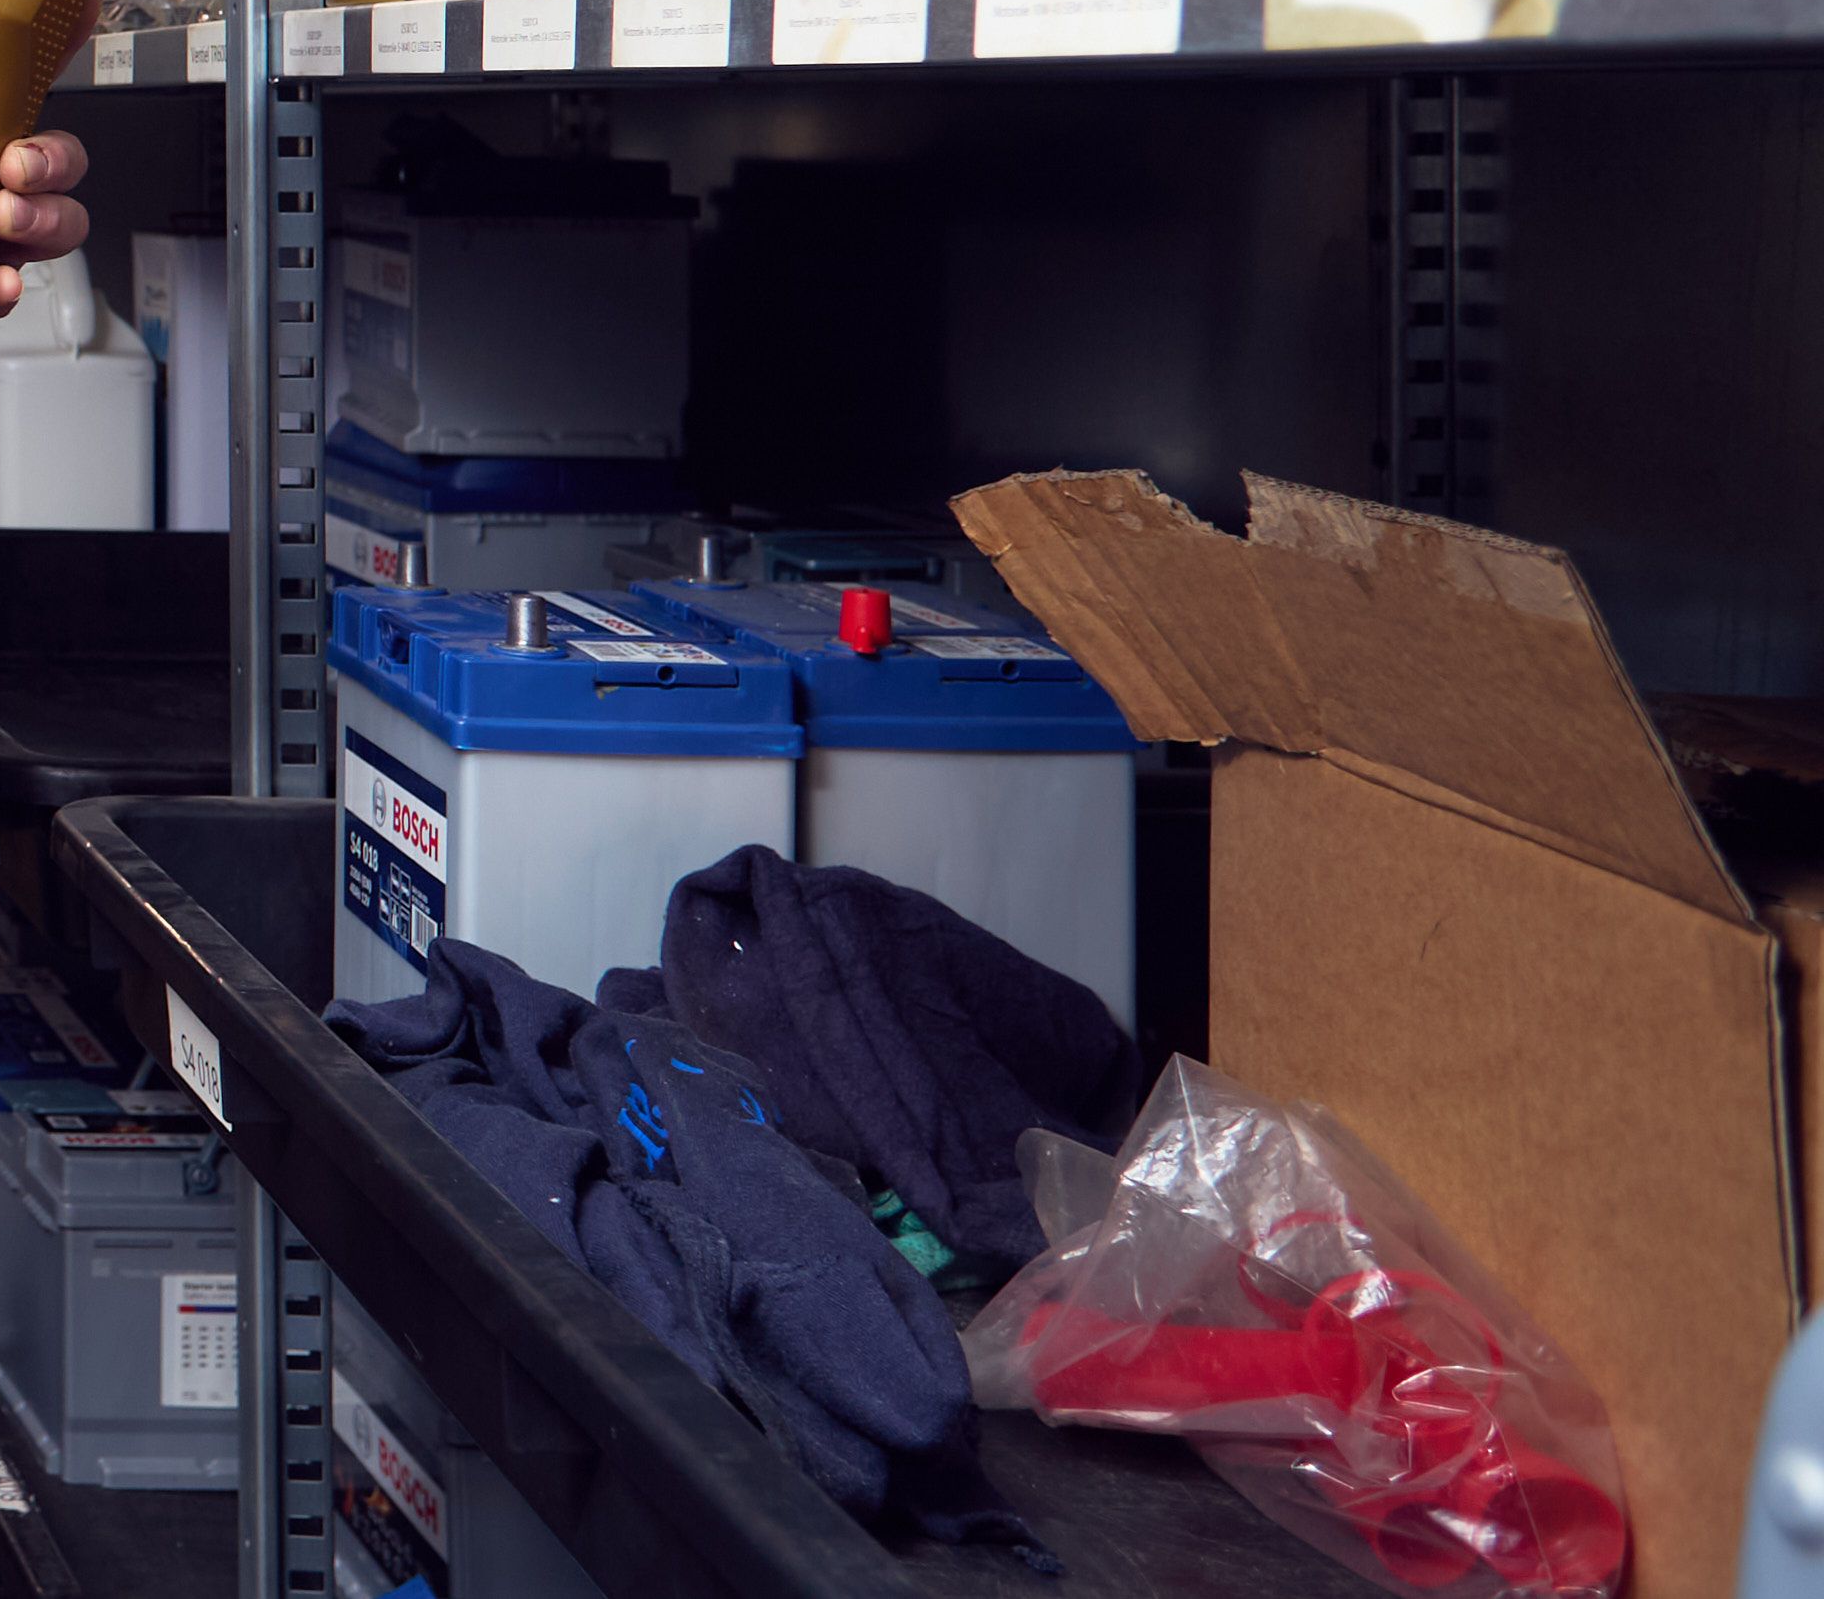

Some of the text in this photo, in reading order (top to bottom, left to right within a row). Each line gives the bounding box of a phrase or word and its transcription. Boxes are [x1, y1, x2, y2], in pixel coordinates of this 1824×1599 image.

[350, 830, 379, 874] S4 018
[392, 796, 440, 863] BOSCH
[180, 1033, 221, 1104] S4 018
[378, 1435, 441, 1538] BOSCH
